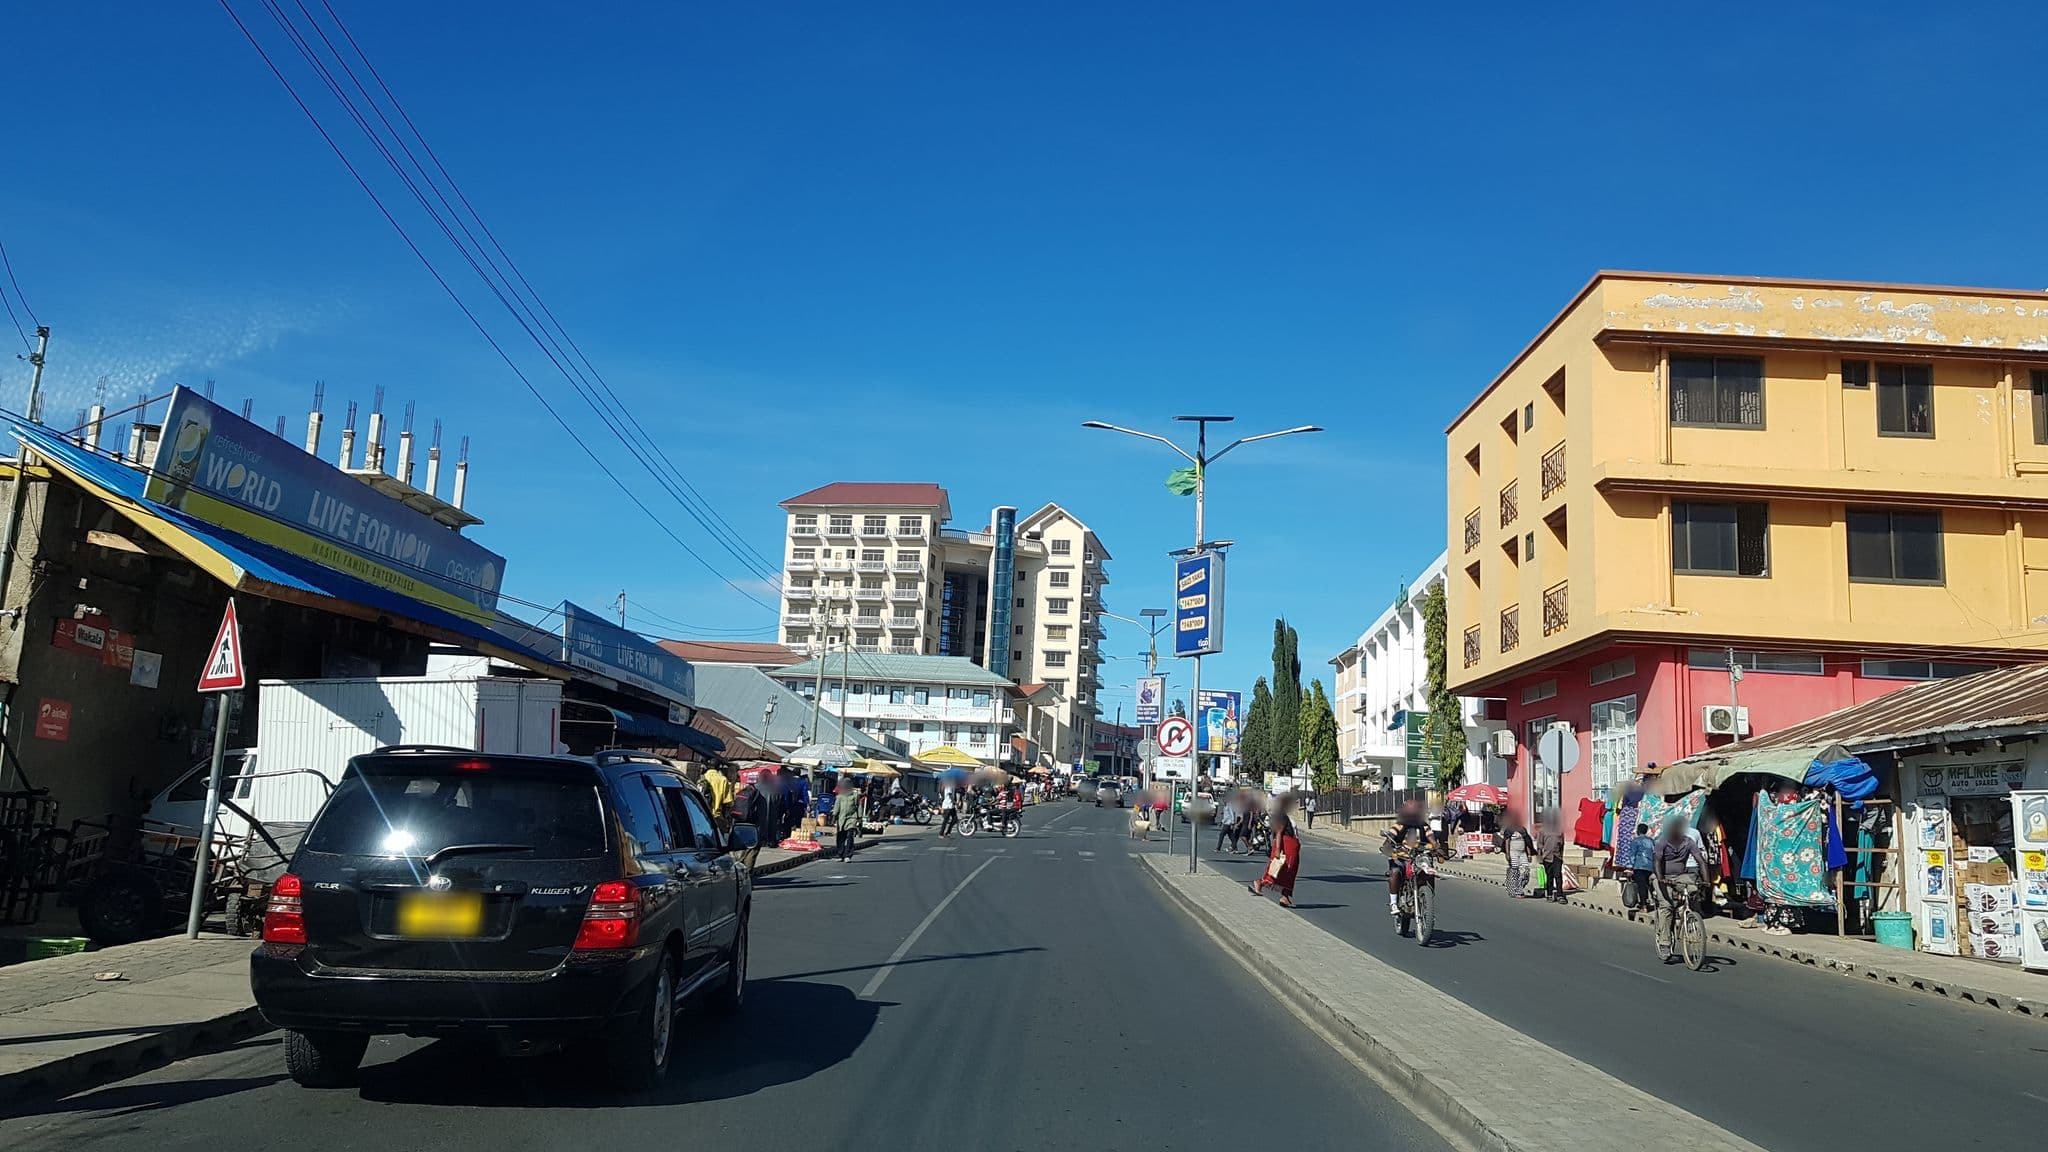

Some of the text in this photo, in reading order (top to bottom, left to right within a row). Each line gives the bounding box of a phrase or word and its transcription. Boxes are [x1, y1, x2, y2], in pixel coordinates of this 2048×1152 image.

[207, 452, 281, 512] WORLD
[307, 490, 431, 569] LIVE FOR NOW
[344, 557, 370, 578] FAMILY
[372, 566, 415, 592] ENTERPRISES
[443, 559, 481, 591] pepsi
[579, 631, 602, 658] WORLD
[618, 641, 634, 669] LIVE
[635, 651, 648, 678] FOR
[51, 707, 68, 720] airtel
[1948, 765, 1998, 779] MFILINGE
[1975, 778, 1999, 787] SPARES
[314, 882, 340, 890] FOUR
[531, 887, 571, 895] KLUGER
